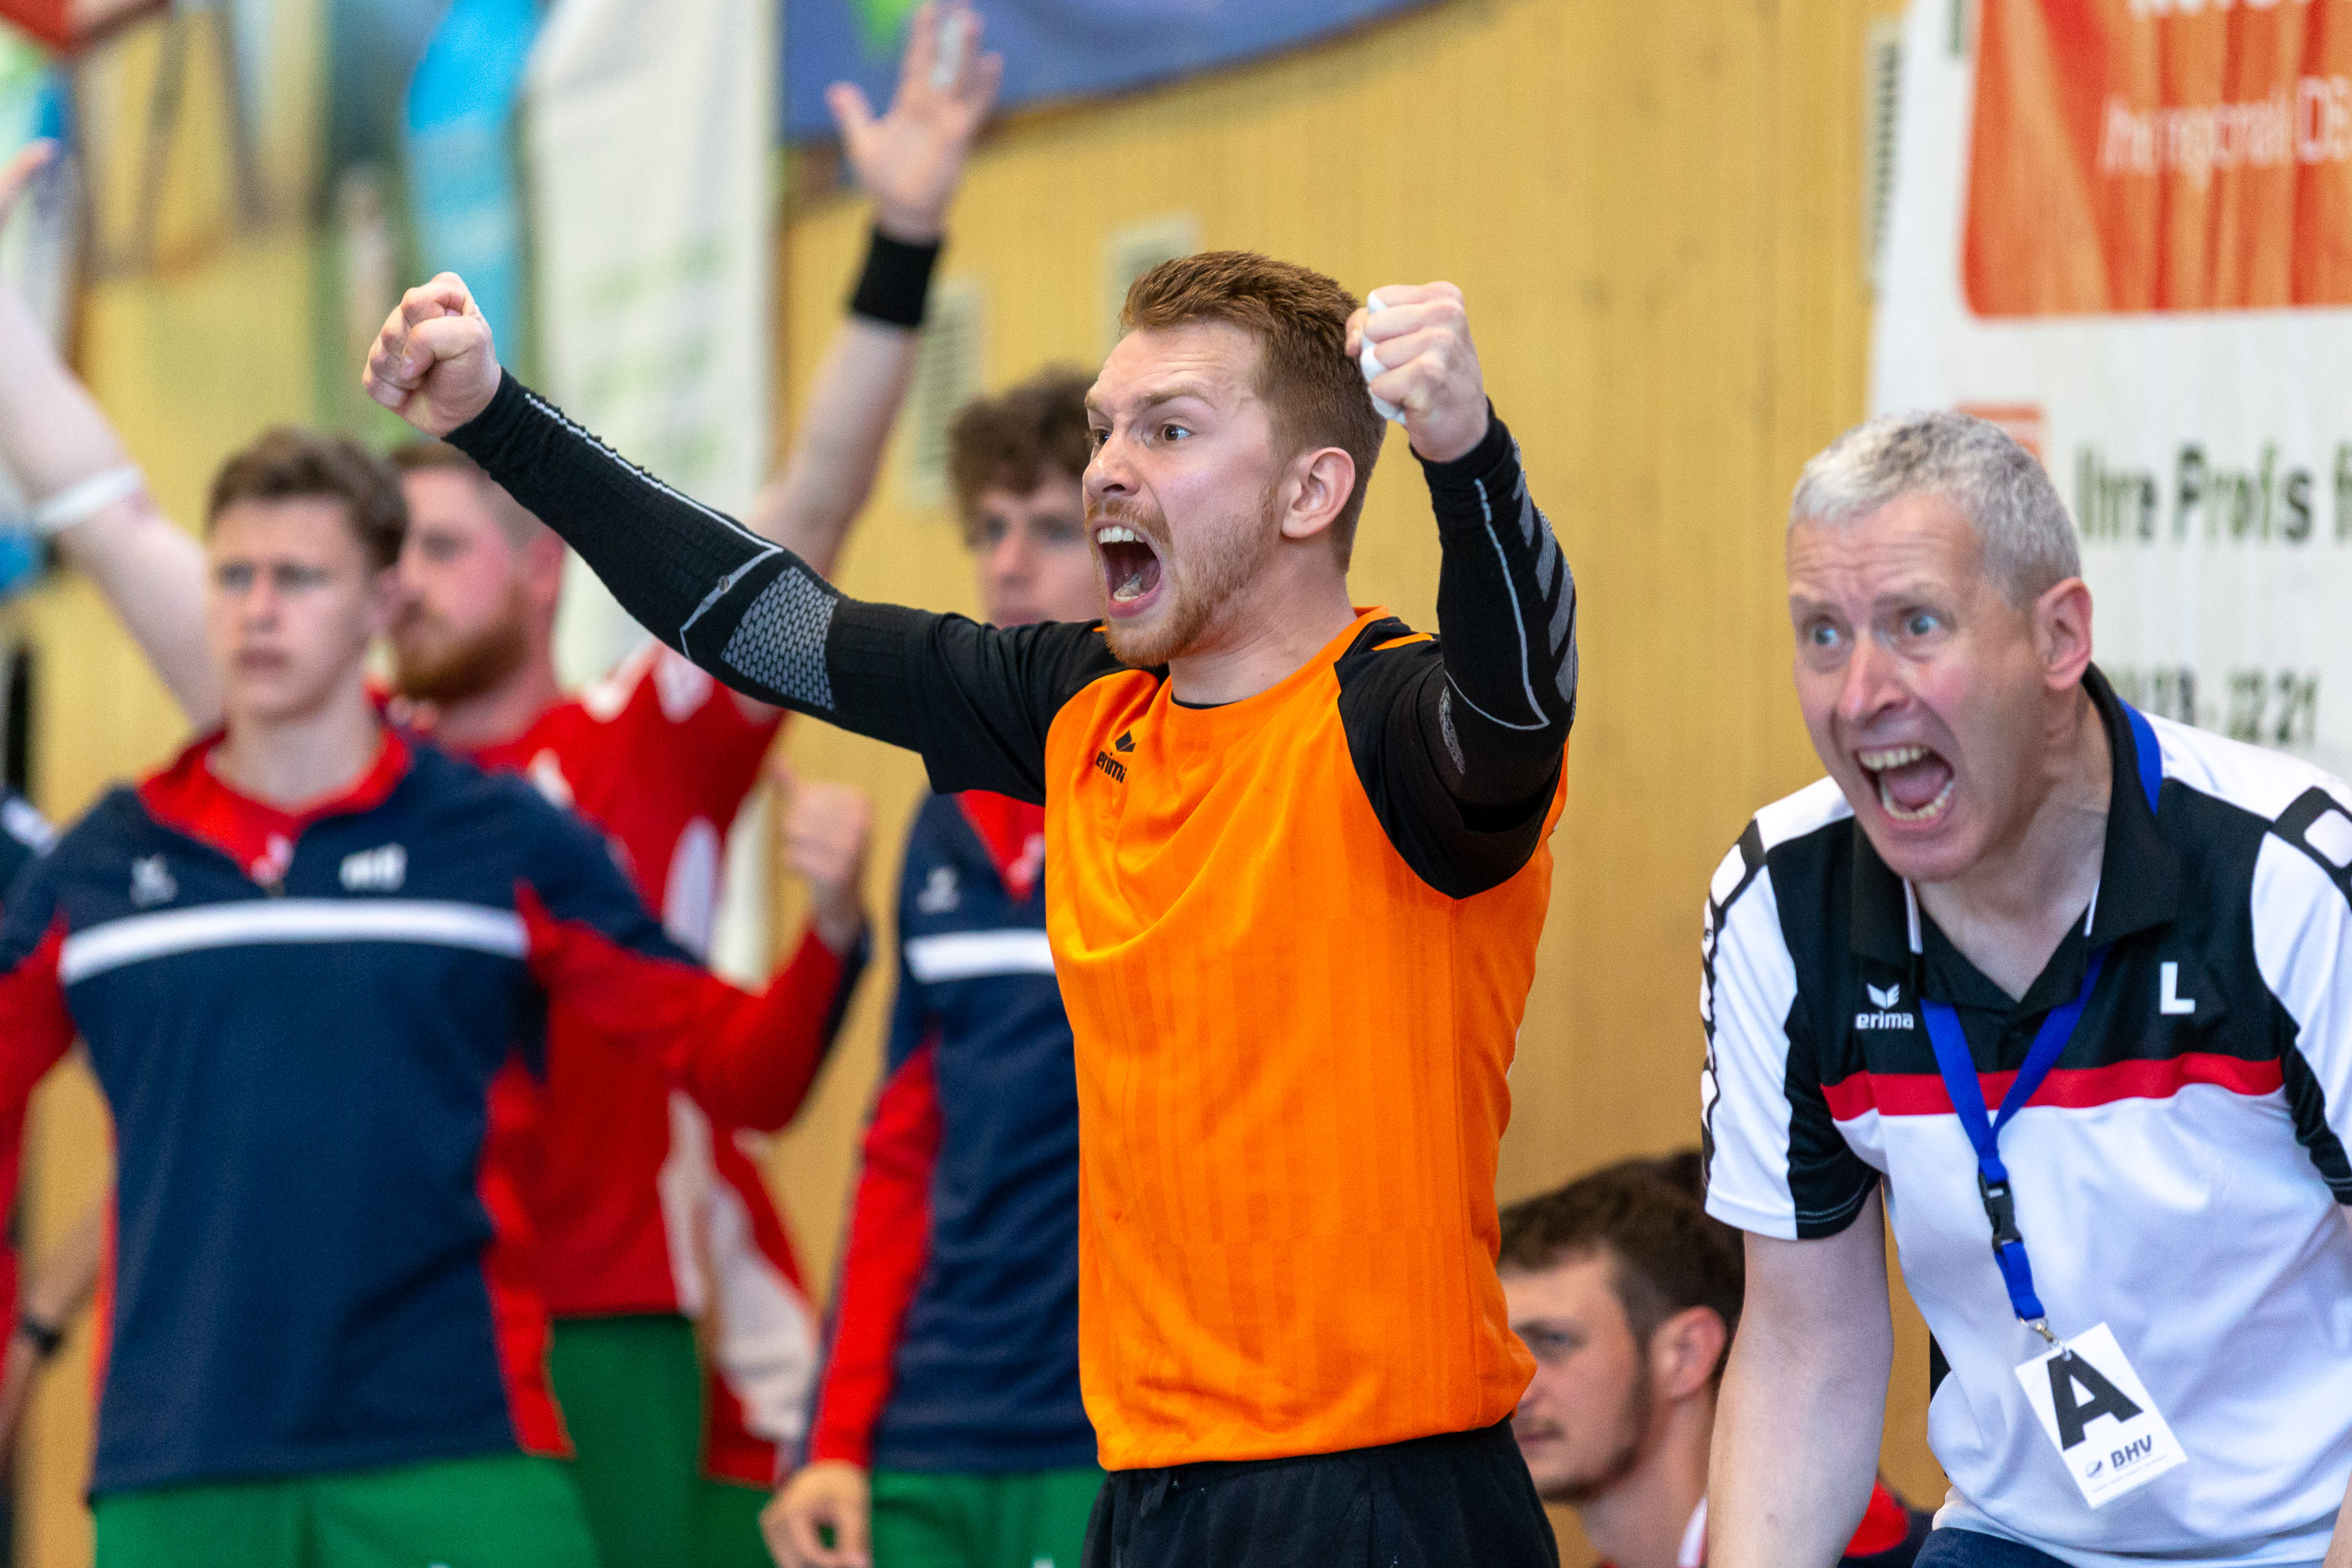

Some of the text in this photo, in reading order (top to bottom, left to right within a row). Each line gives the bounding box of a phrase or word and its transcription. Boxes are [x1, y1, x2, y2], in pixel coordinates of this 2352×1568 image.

[2160, 961, 2196, 1015] L
[1855, 1009, 1914, 1030] erima
[2047, 1349, 2144, 1451] A
[2110, 1435, 2152, 1468] BHV
